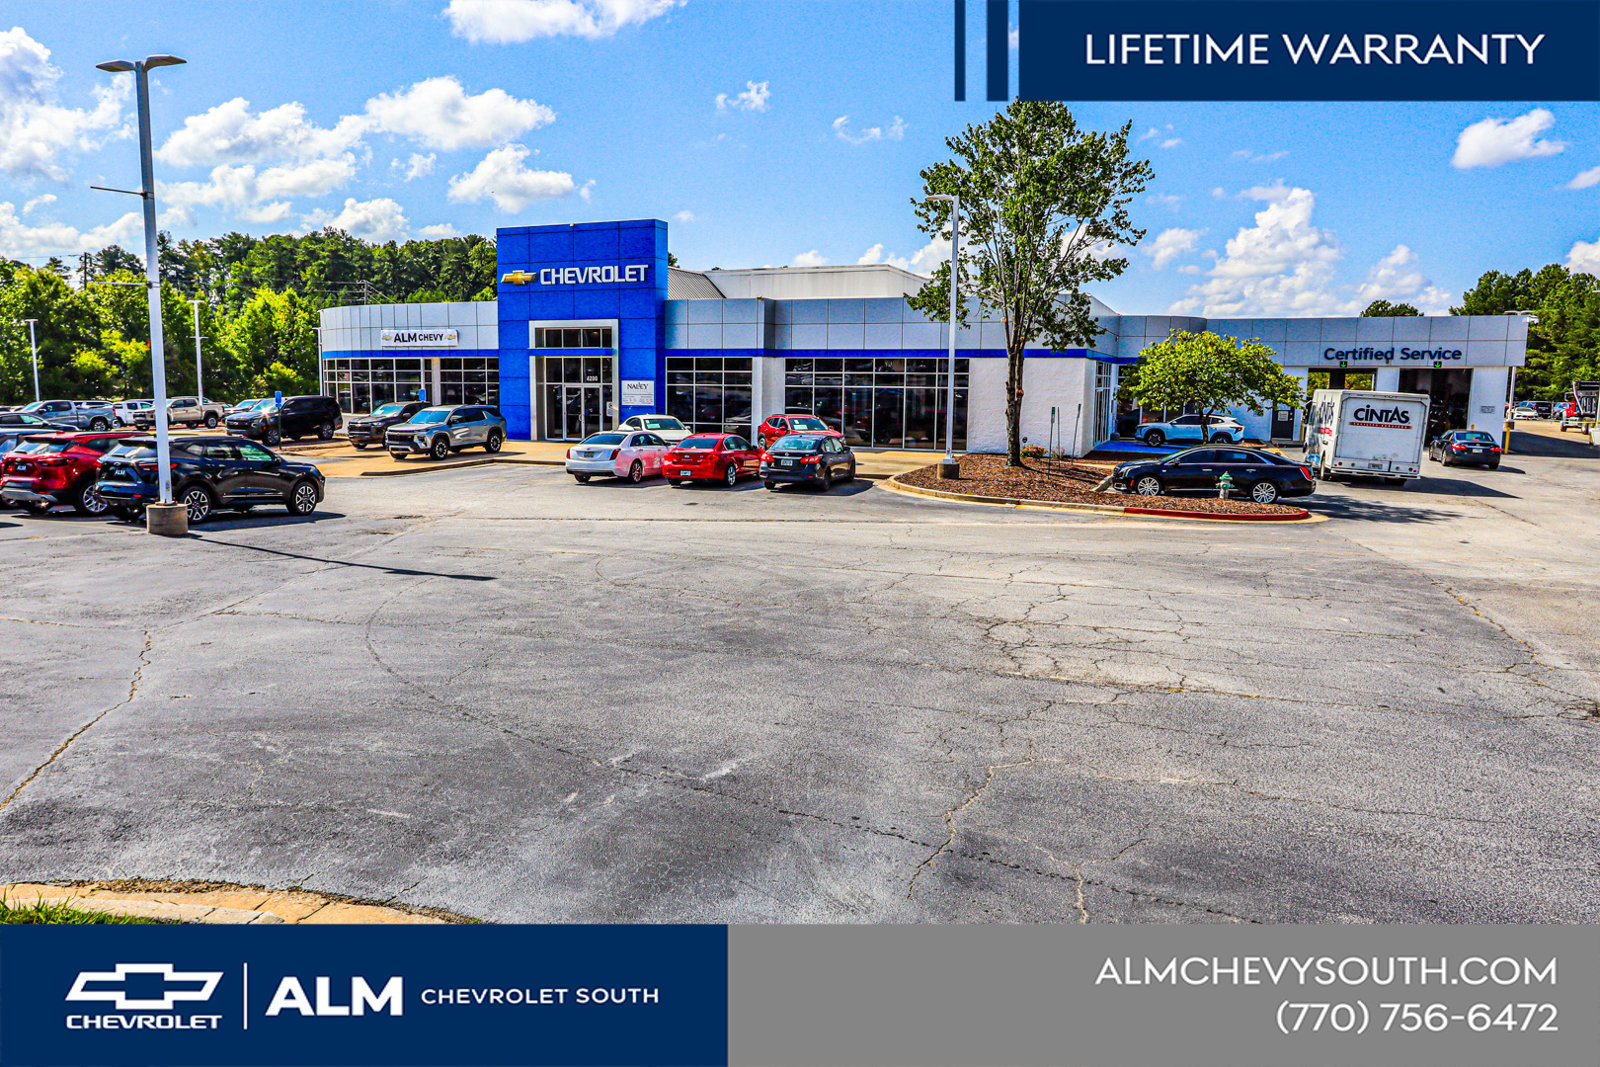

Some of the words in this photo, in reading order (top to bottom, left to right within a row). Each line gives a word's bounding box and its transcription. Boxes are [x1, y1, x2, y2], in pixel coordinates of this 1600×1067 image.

[540, 264, 649, 286] CHEVROLET
[393, 332, 417, 343] ALM
[418, 333, 444, 342] CHEVY
[1324, 347, 1394, 360] Certified
[1400, 347, 1462, 360] Service
